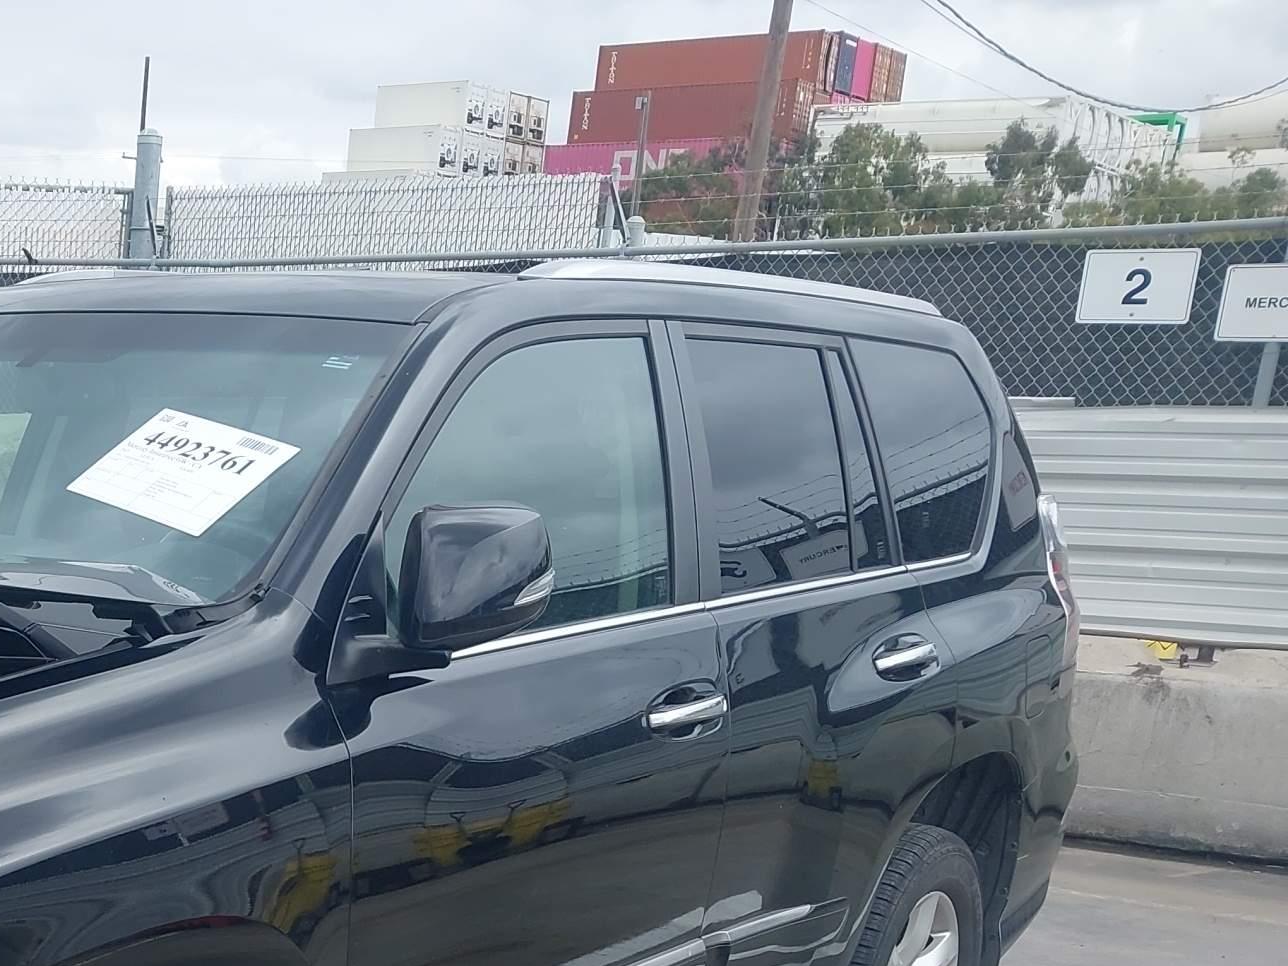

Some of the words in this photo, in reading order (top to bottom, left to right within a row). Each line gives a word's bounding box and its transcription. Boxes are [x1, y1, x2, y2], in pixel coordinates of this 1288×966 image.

[1121, 268, 1152, 305] 2
[1244, 296, 1288, 309] MERC
[144, 431, 257, 475] 44923761
